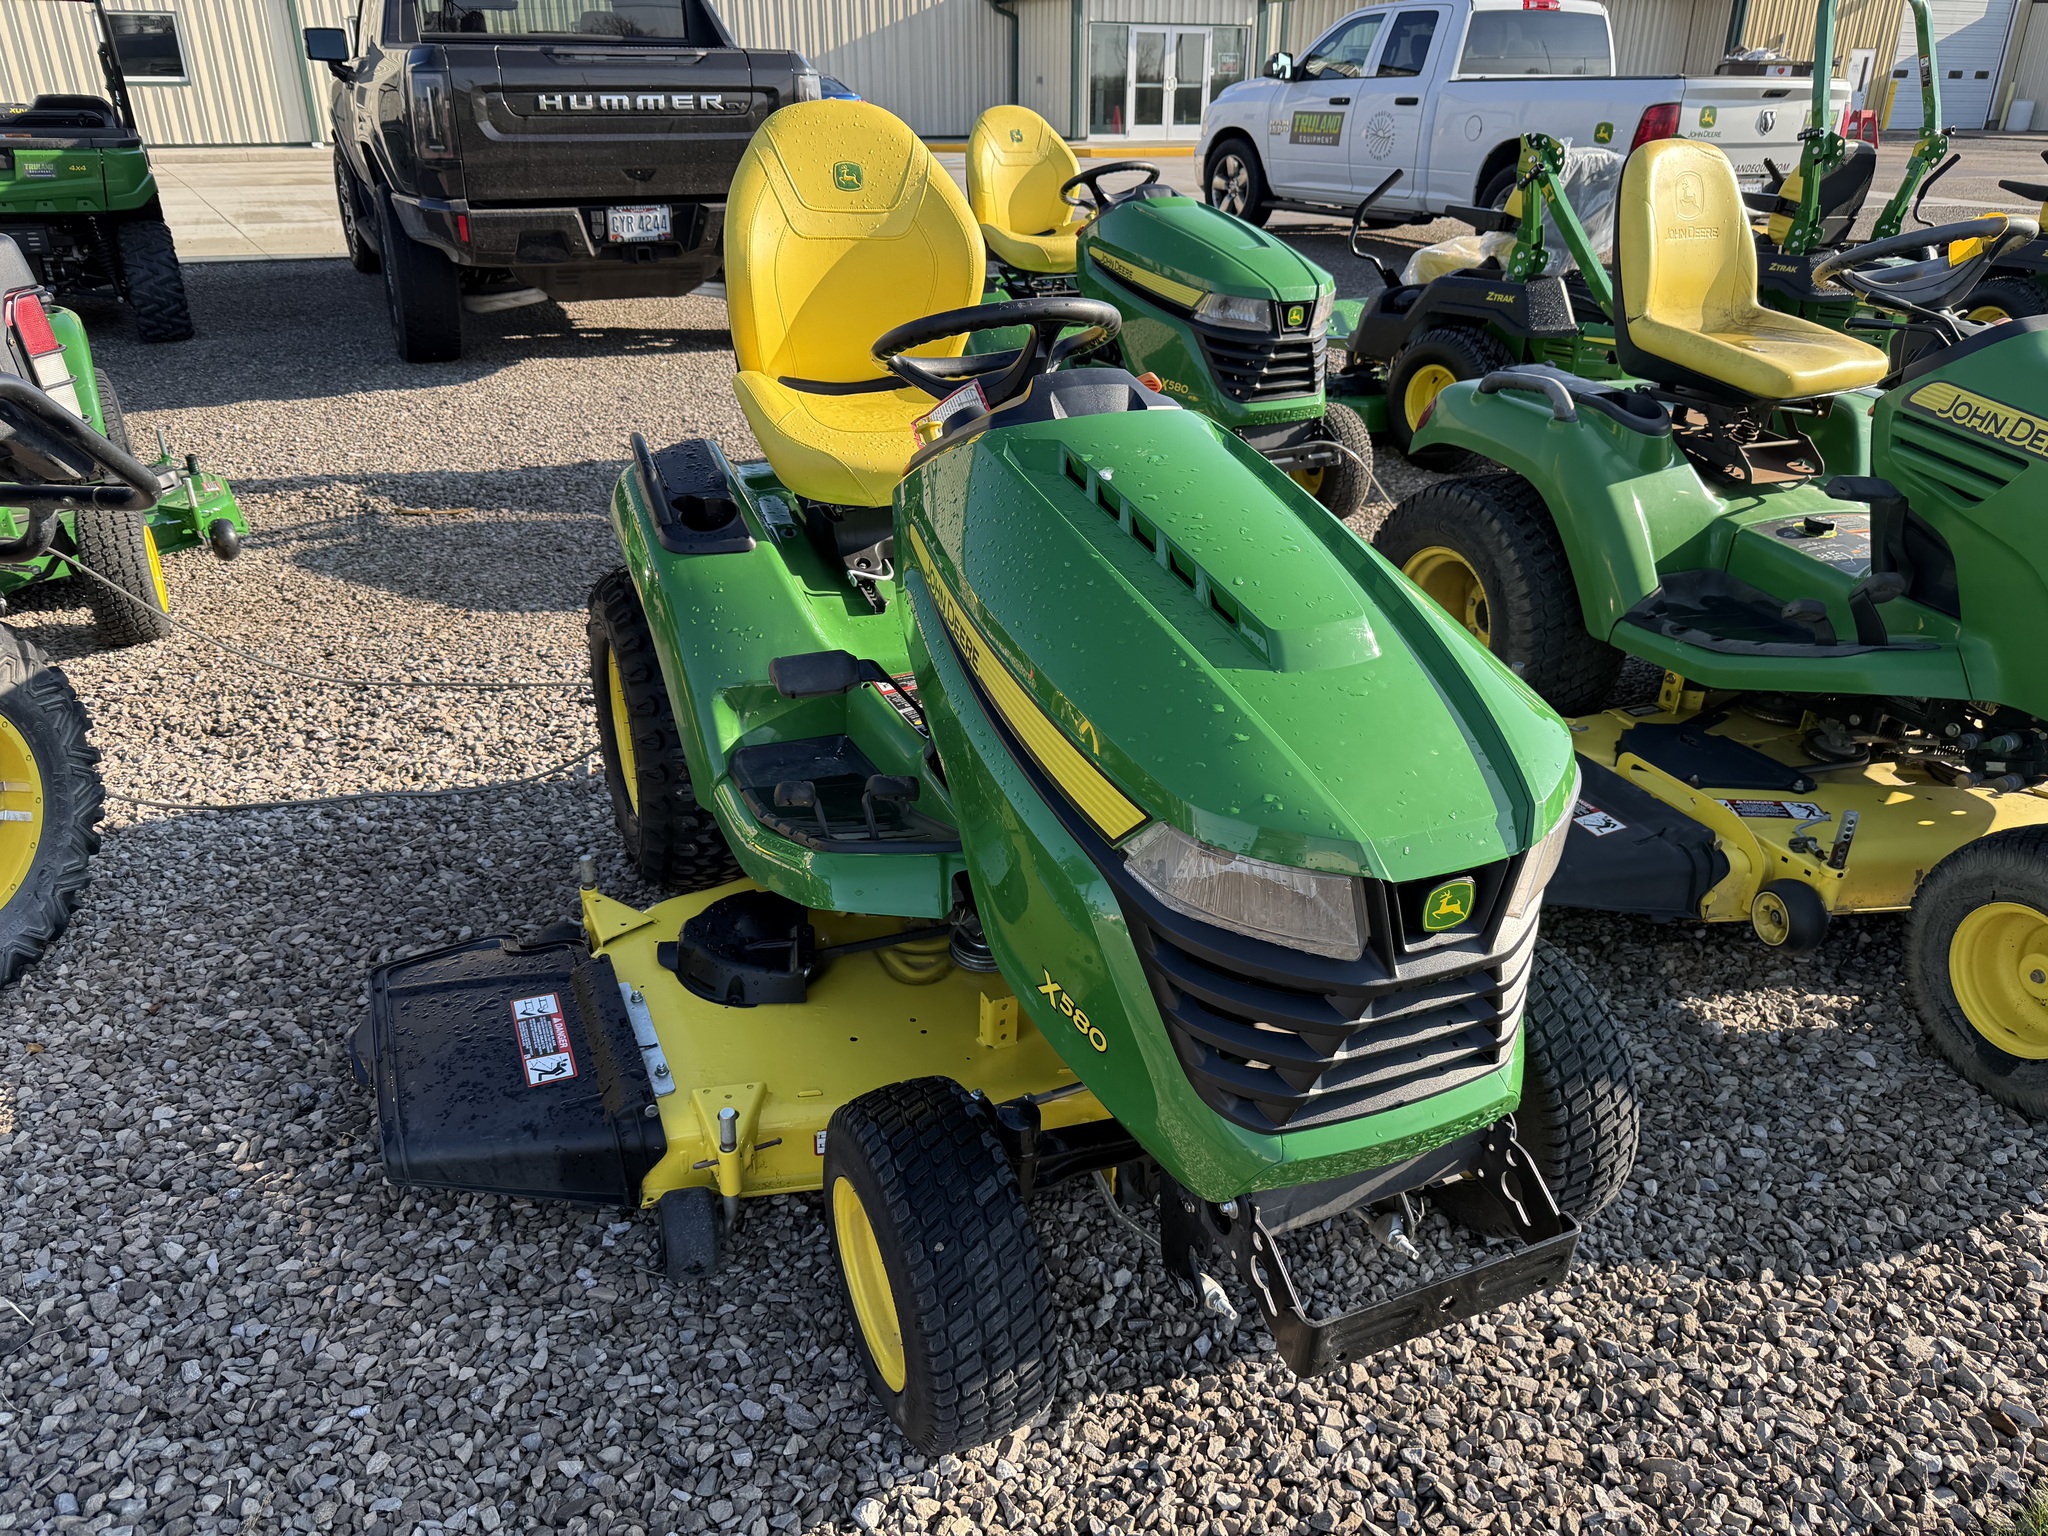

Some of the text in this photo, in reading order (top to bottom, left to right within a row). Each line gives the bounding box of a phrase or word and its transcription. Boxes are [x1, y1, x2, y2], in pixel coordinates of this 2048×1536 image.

[538, 94, 724, 110] HUMMER
[1293, 114, 1342, 134] TRULAND
[1299, 134, 1333, 144] EQUIPMENT
[1688, 130, 1721, 138] JOHN DEERE
[638, 214, 667, 232] 4244
[1665, 226, 1719, 239] JOHN DEERE
[1100, 253, 1134, 280] JOHN DEERE
[1486, 291, 1515, 303] ZTRAK
[1162, 378, 1189, 394] X580
[1937, 394, 2009, 434] JOHN
[925, 559, 980, 672] JOHN DEERE
[1036, 965, 1108, 1052] X580
[554, 1023, 568, 1049] DANGER
